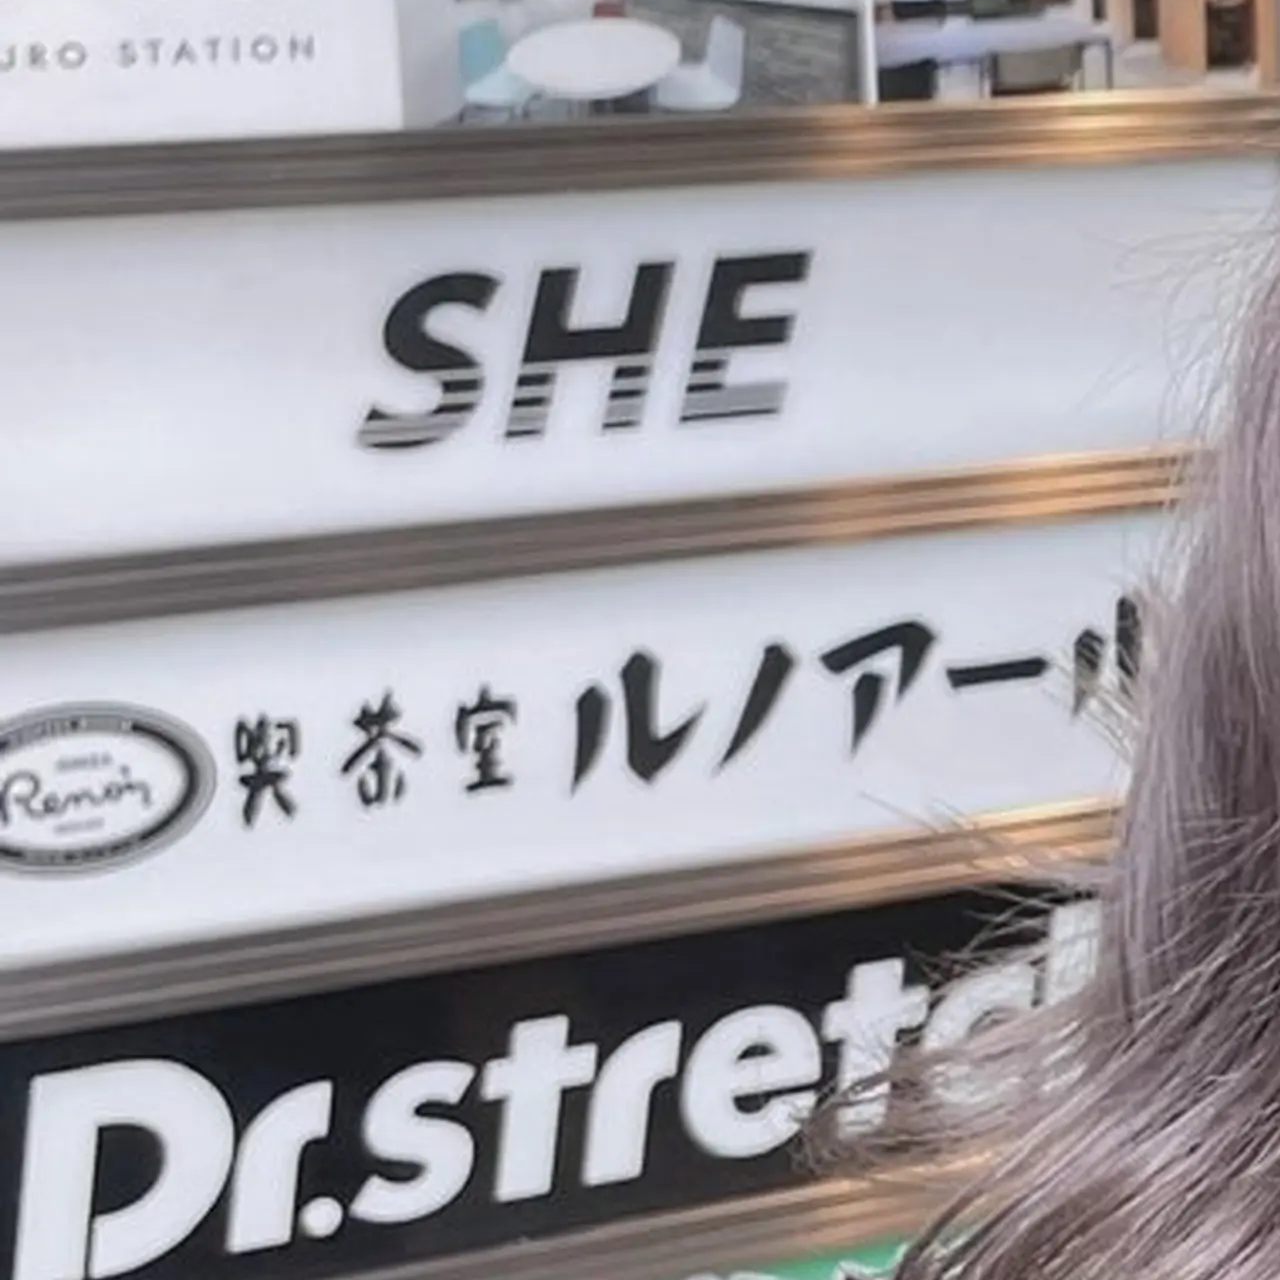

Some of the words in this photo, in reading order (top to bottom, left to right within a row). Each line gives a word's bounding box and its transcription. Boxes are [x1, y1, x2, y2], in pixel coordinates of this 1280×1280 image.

[119, 35, 315, 68] STATION
[357, 247, 814, 451] SHE
[234, 684, 522, 830] 喫茶室
